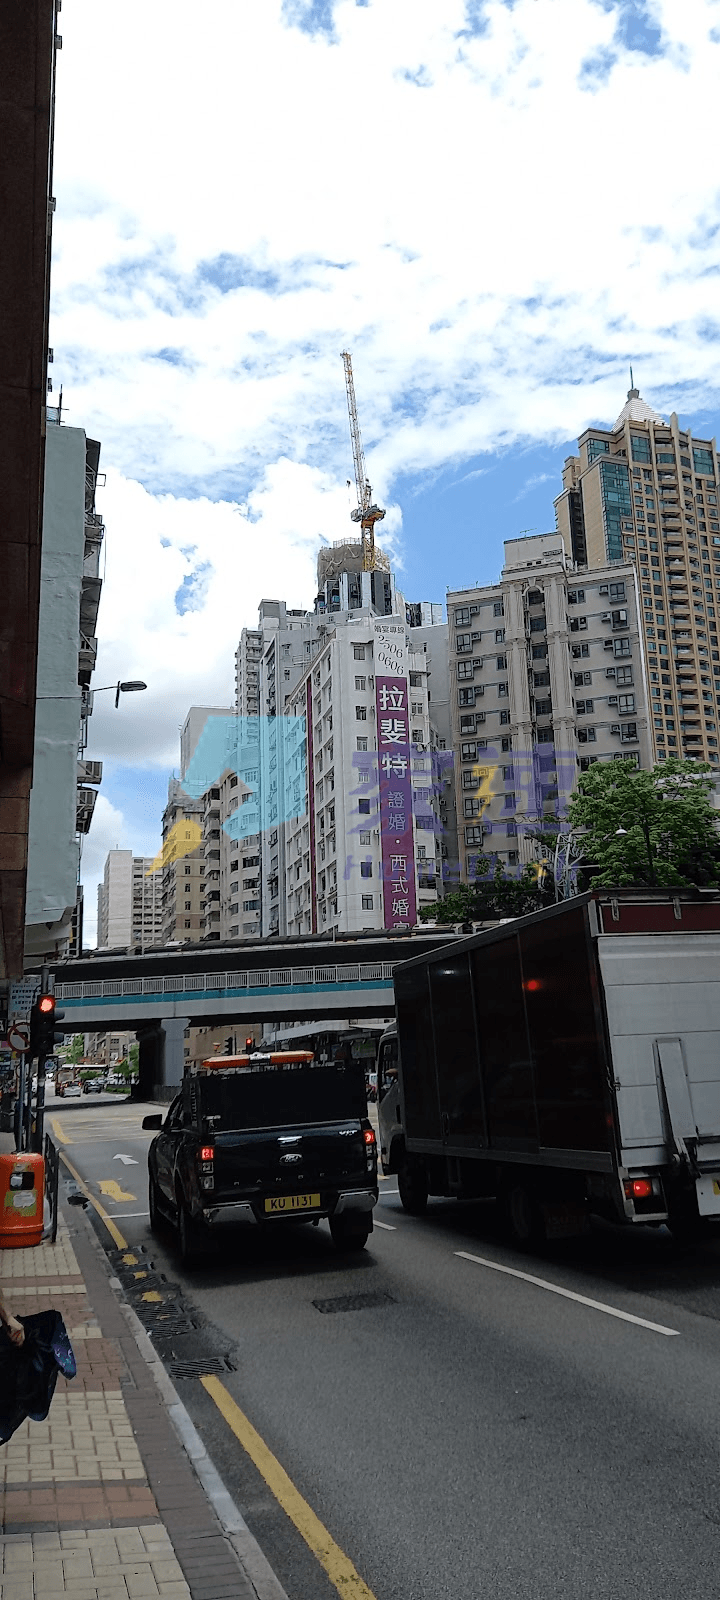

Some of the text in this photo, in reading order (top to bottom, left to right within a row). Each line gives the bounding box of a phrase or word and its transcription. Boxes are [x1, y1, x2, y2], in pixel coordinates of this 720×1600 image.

[377, 635, 403, 658] 2506
[378, 652, 404, 675] 0606
[379, 684, 408, 779] 拉斐特
[270, 1195, 312, 1209] KU 1131
